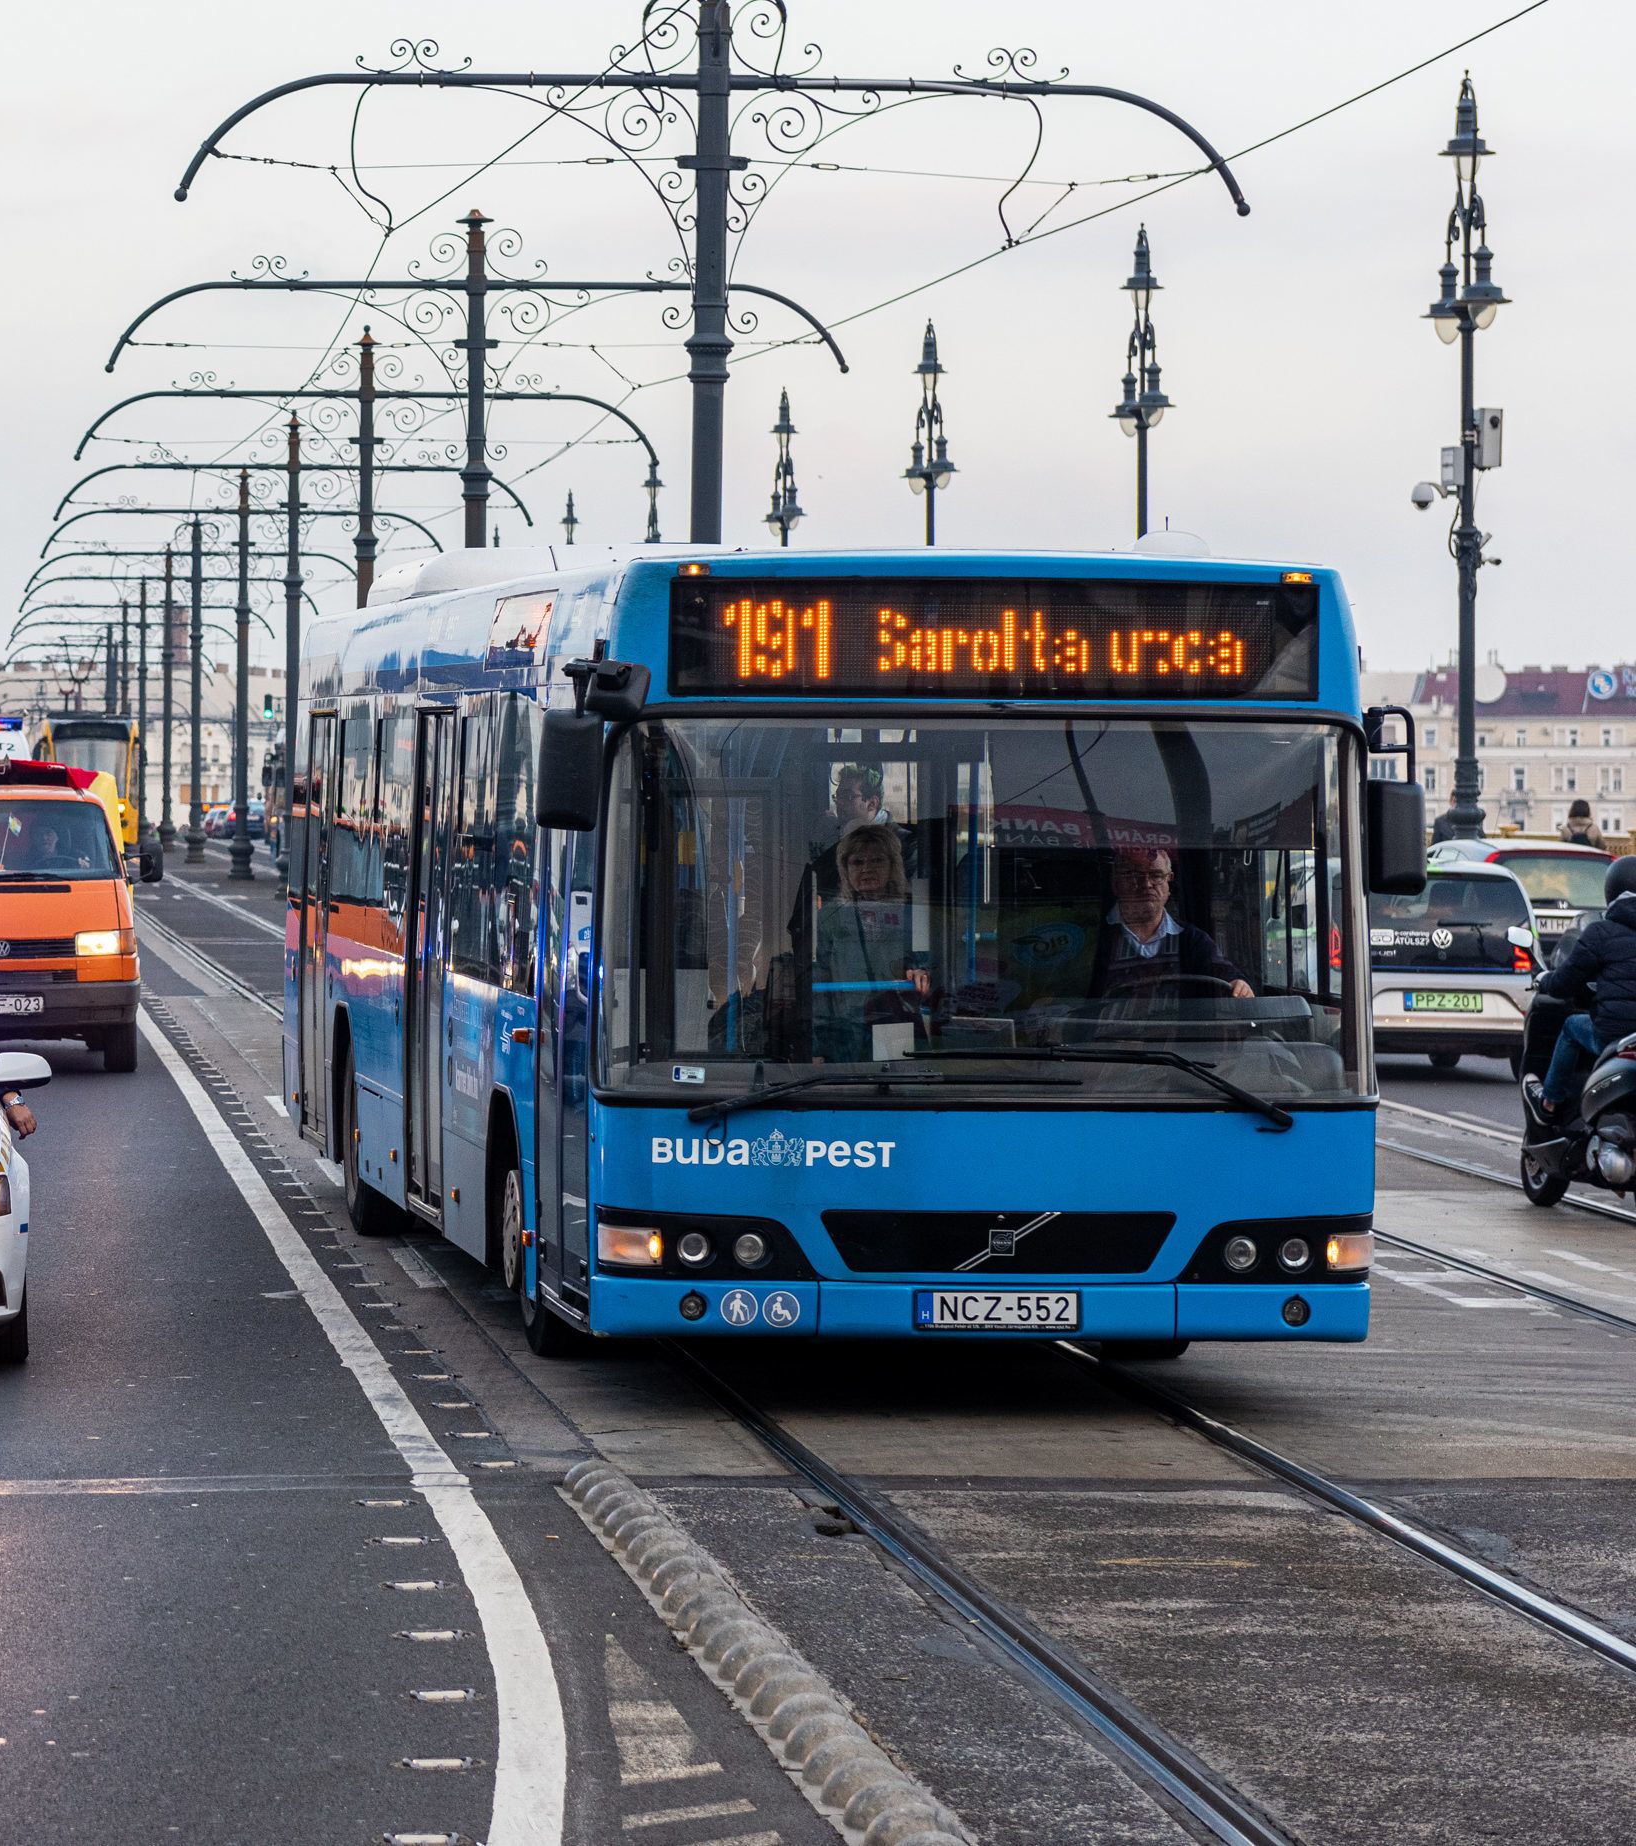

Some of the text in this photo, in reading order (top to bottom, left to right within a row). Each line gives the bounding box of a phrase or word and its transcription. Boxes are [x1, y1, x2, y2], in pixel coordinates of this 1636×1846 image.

[724, 599, 832, 679] 191
[1415, 994, 1478, 1008] PPZ-201
[921, 1310, 930, 1319] H
[939, 1296, 1070, 1322] NCZ-552
